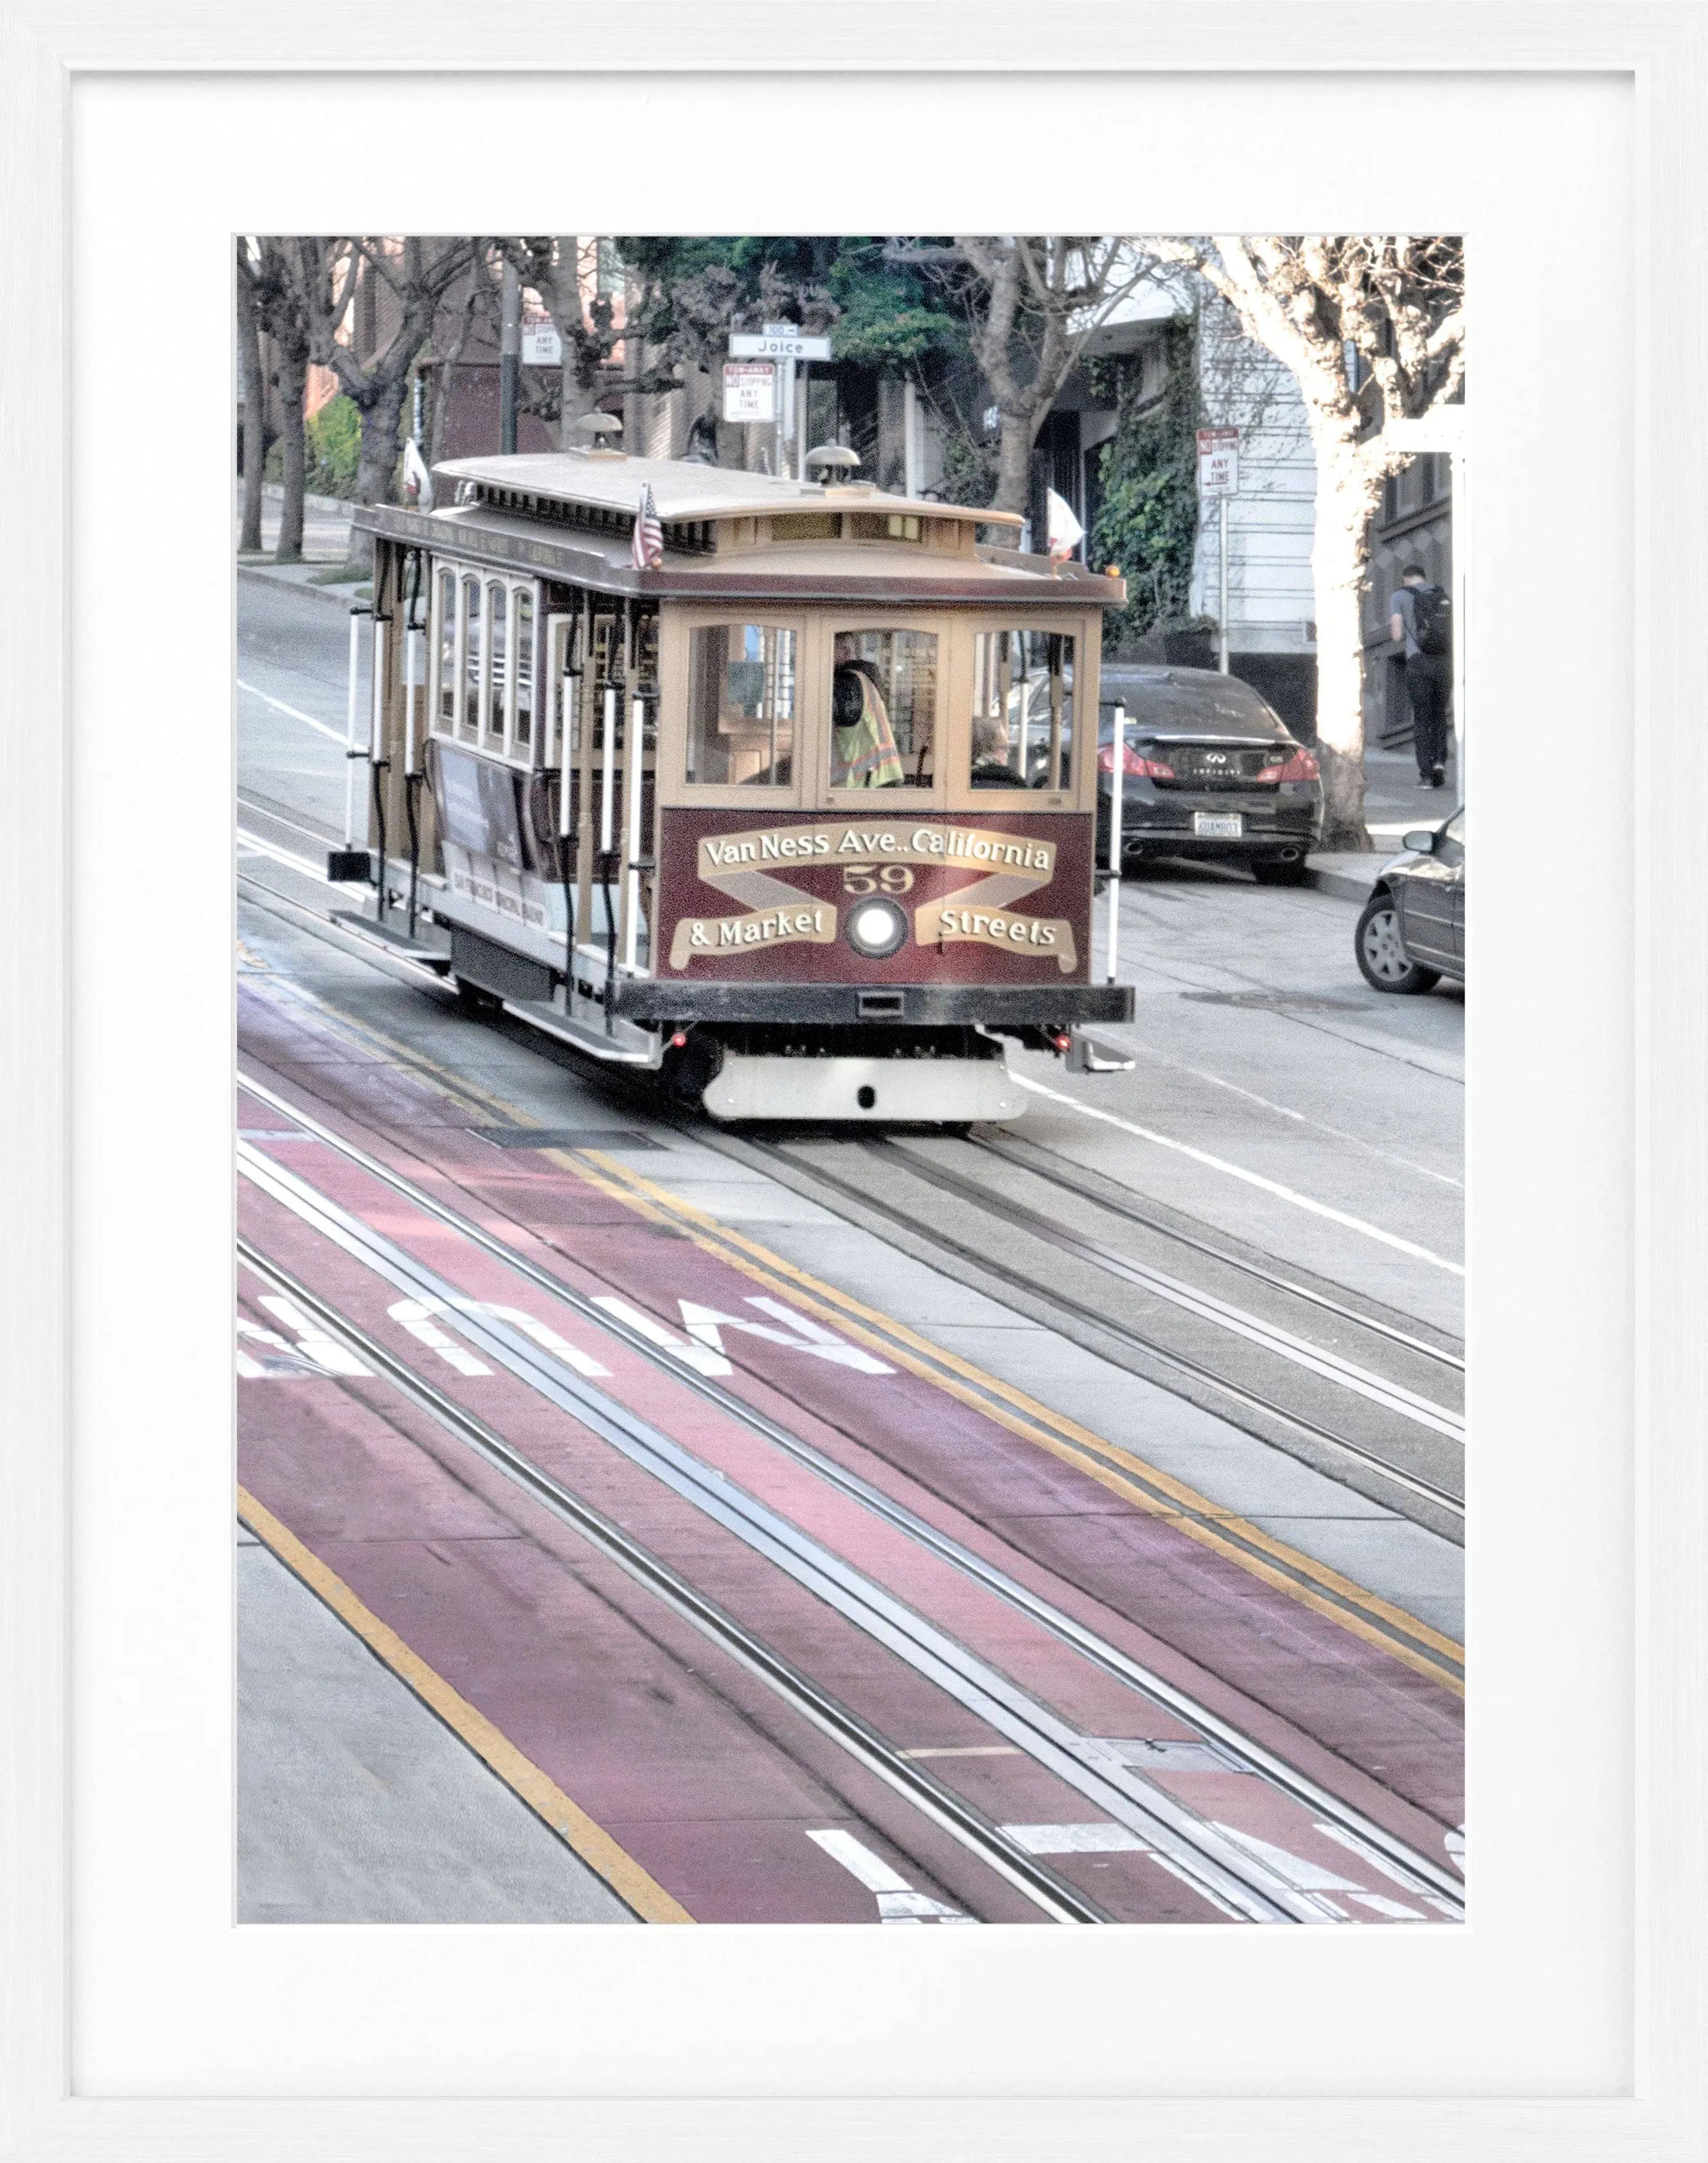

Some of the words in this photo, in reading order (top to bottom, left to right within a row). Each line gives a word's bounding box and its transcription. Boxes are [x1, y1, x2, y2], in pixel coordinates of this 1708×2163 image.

[758, 340, 803, 353] Joice
[740, 389, 758, 398] ANY
[739, 399, 760, 409] TIME
[1199, 439, 1211, 452] NO
[1211, 458, 1229, 469] ANY
[1210, 470, 1230, 482] TIME
[706, 840, 756, 866] Van
[756, 833, 830, 860] Ness
[911, 828, 1050, 870] California
[843, 865, 914, 895] 59
[689, 921, 711, 947] &
[718, 909, 823, 947] Market
[939, 909, 1056, 946] Streets
